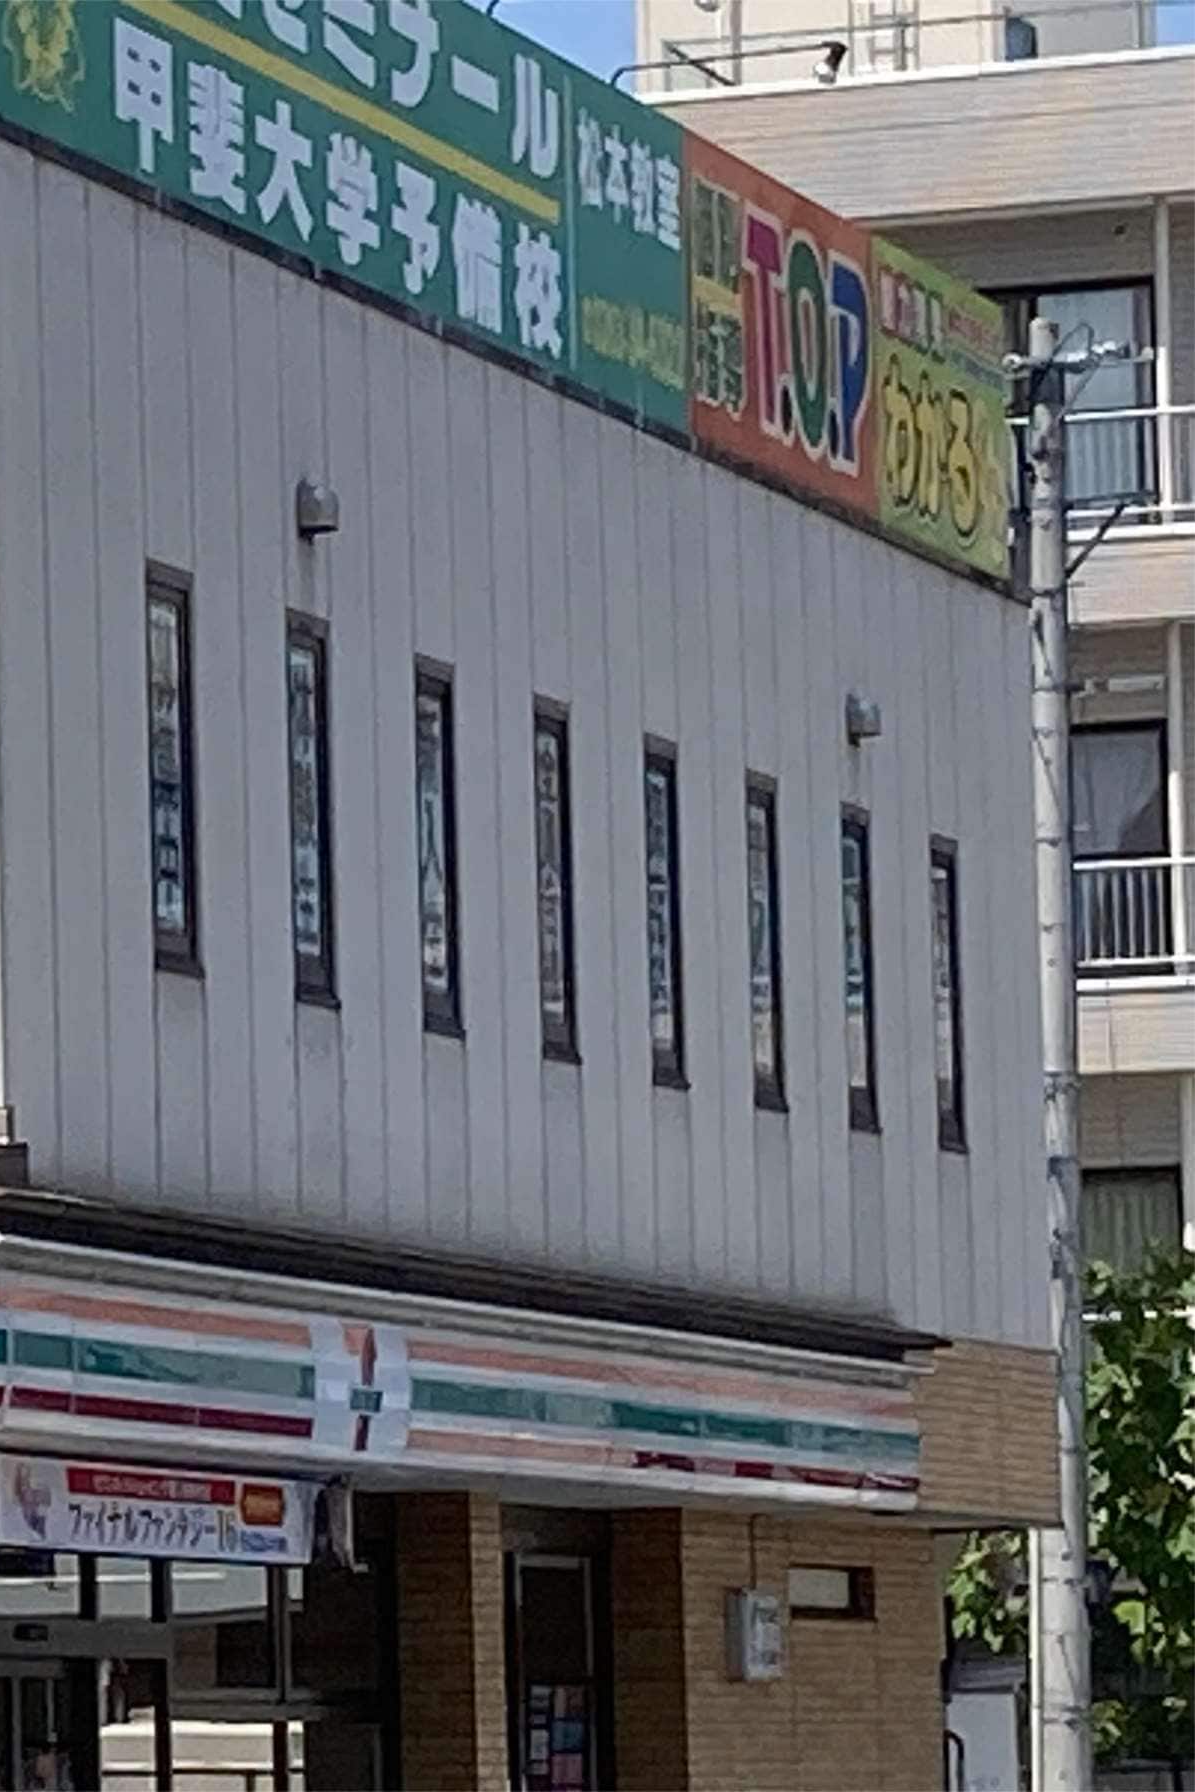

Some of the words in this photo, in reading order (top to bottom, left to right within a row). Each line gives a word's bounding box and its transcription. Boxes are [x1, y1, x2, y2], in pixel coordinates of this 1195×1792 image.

[114, 17, 563, 359] 甲斐大学予備校
[212, 0, 559, 179] ミナール
